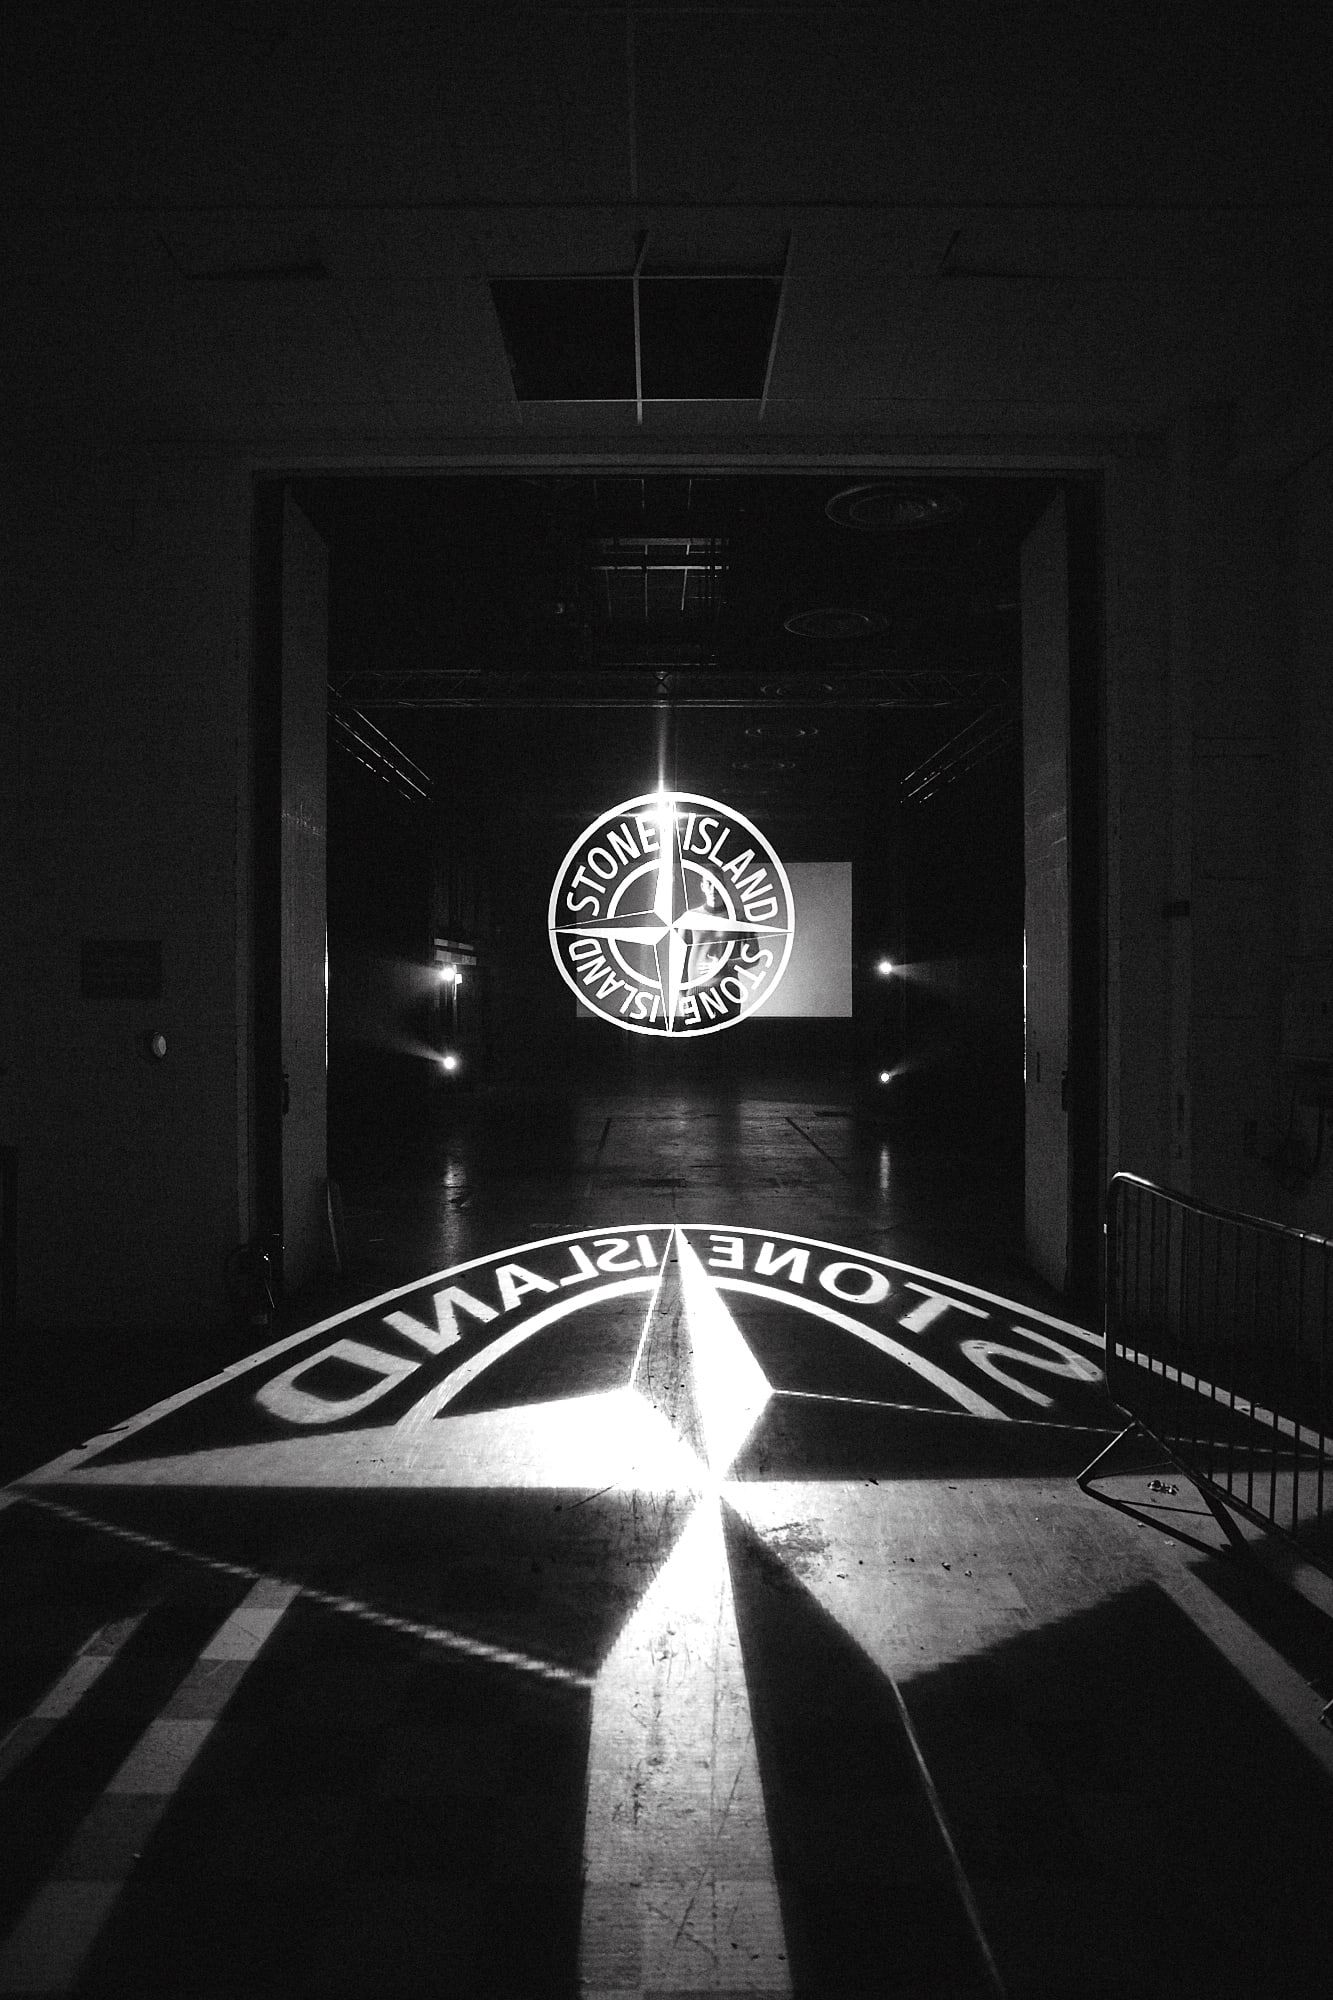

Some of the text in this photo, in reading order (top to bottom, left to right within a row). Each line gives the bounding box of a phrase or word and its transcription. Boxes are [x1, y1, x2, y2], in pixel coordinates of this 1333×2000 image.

[566, 812, 779, 922] STONE ISLAND
[568, 938, 774, 1025] STONE ISLAND
